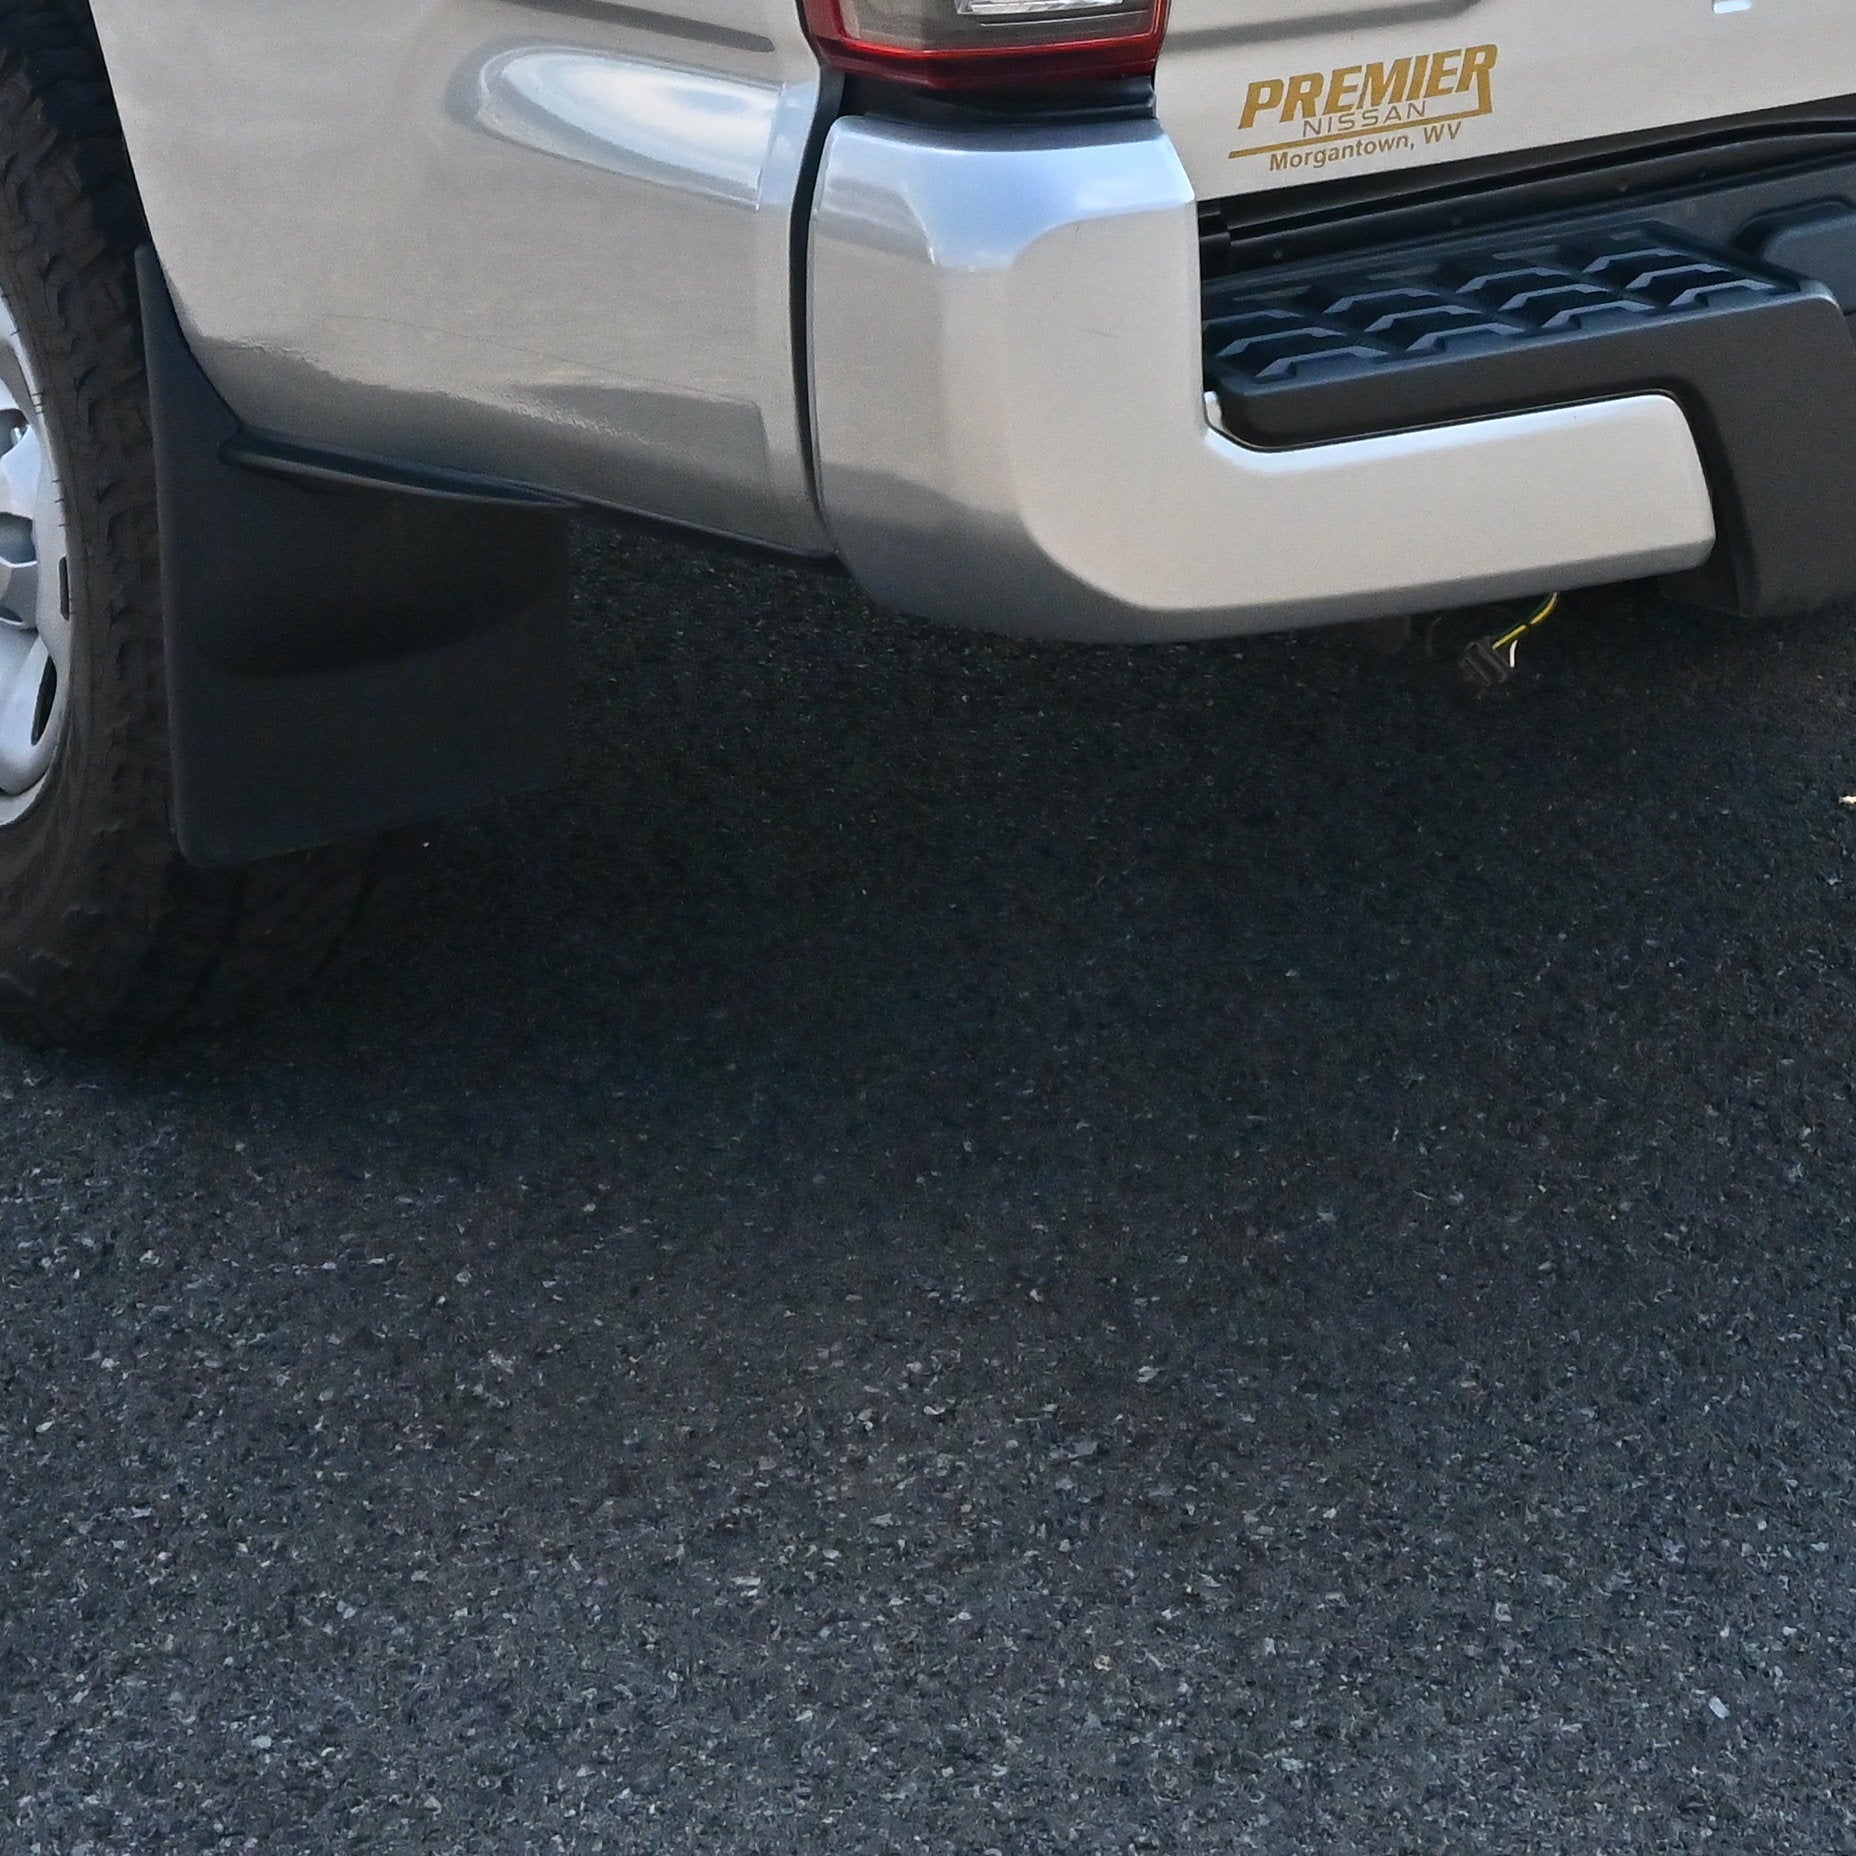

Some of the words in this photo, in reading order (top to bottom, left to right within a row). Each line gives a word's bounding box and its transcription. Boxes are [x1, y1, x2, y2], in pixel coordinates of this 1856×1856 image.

[1238, 43, 1498, 130] PREMIER
[1302, 101, 1427, 138] NISSAN
[1269, 133, 1415, 171] Morgantown,
[1422, 121, 1462, 145] WV
